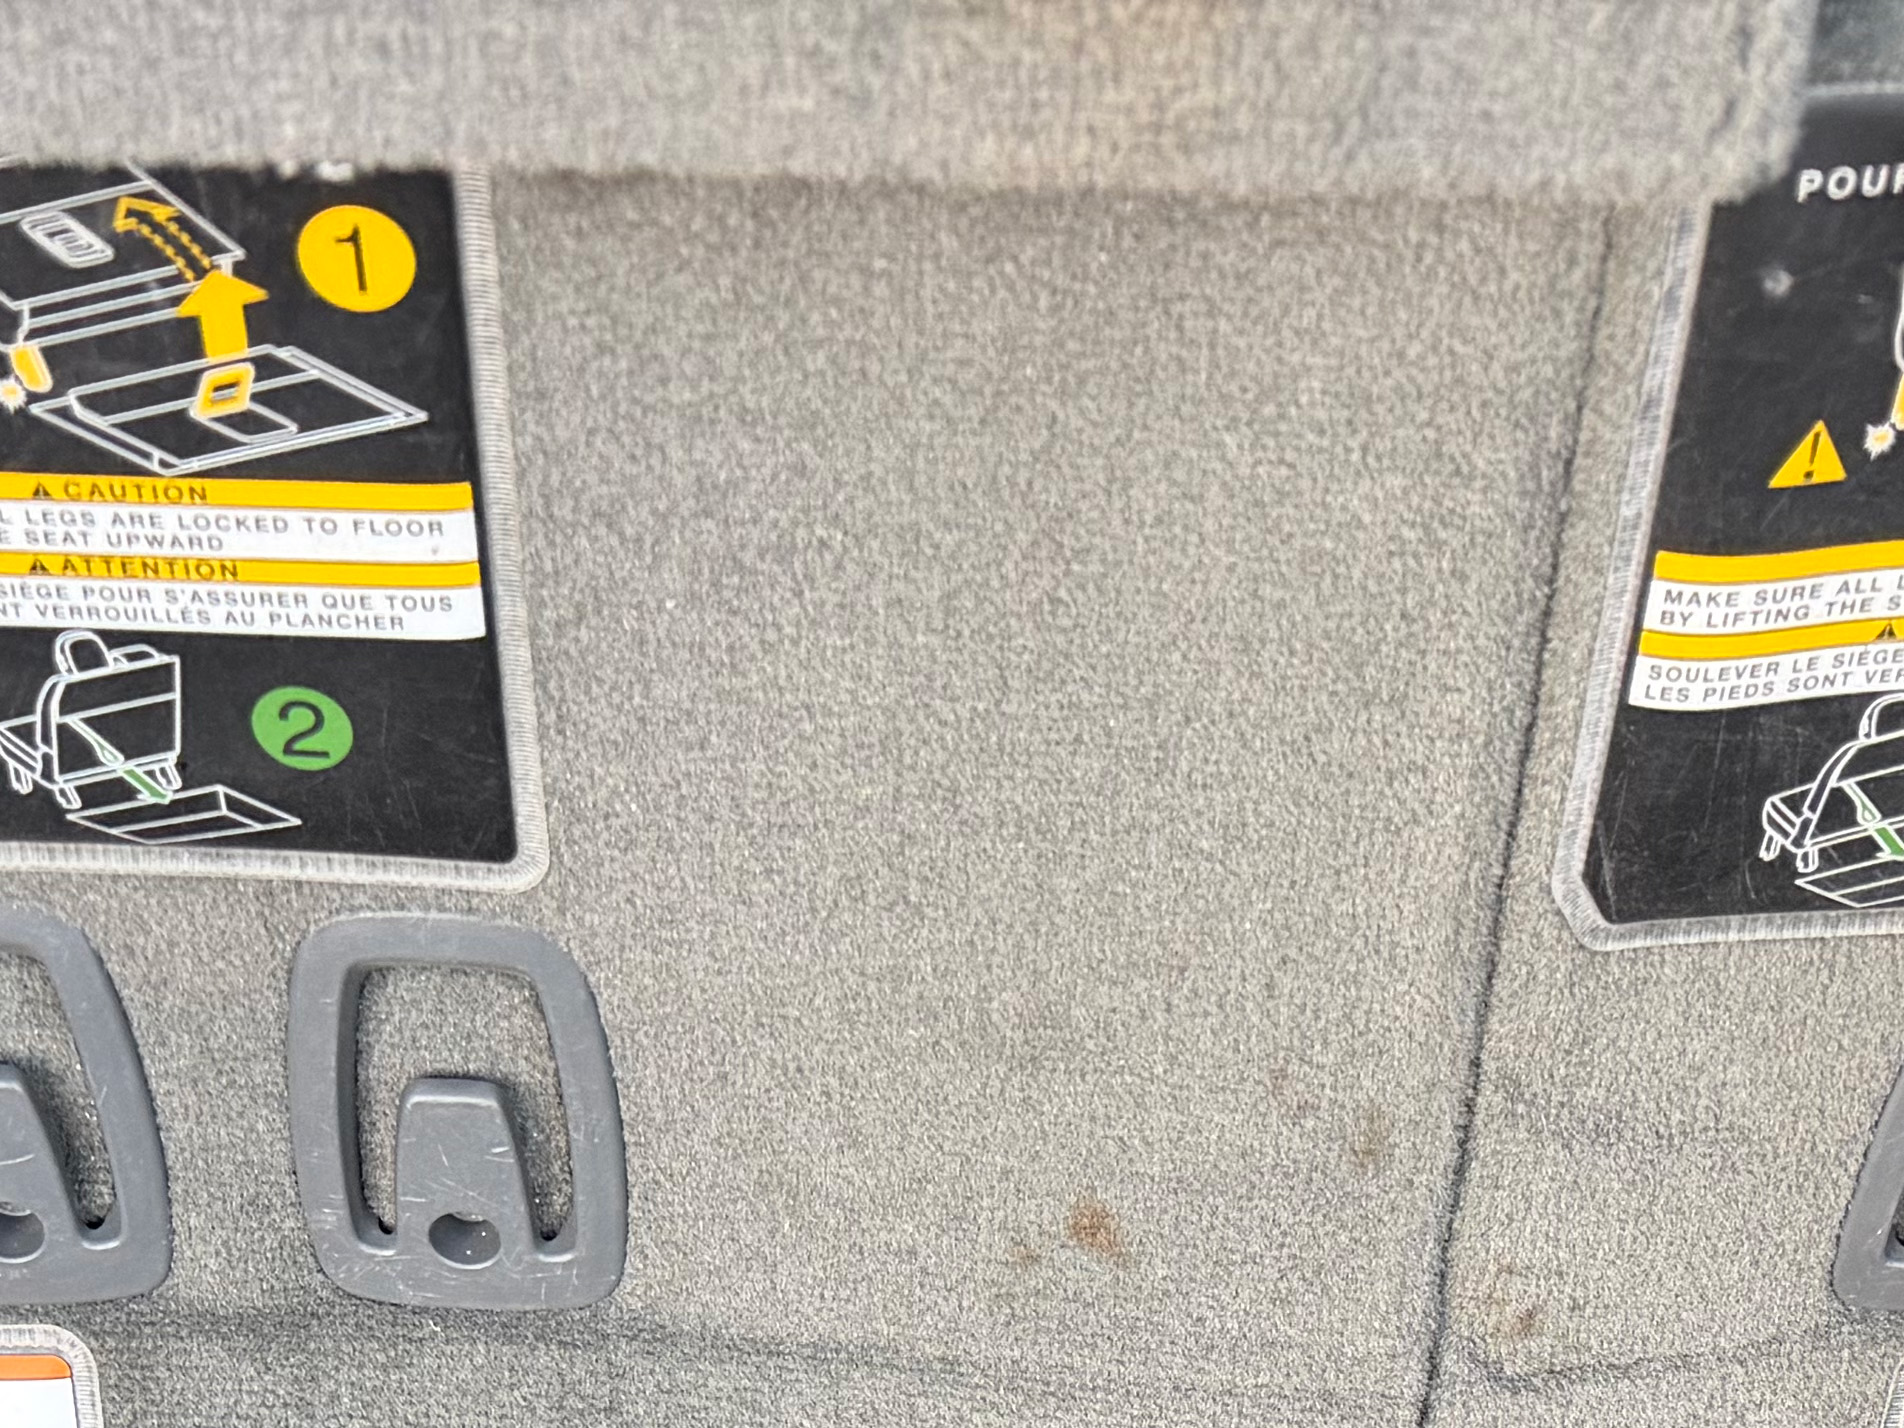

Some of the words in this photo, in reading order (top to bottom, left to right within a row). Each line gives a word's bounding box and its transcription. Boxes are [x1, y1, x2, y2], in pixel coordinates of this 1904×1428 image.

[334, 224, 367, 295] 1
[63, 482, 208, 502] CAUTION
[25, 507, 97, 528] LEGS
[110, 511, 165, 531] ARE
[177, 513, 289, 535] LOCKED
[304, 517, 338, 536] TO
[352, 518, 444, 538] FLOOR
[25, 529, 94, 548] SEAT
[106, 532, 223, 552] UPWARD
[60, 556, 239, 581] ATTENTION
[82, 583, 151, 602] POUR
[164, 587, 309, 609] S'ASSURER
[321, 592, 374, 611] QUE
[386, 593, 453, 613] TOUS
[1663, 588, 1740, 608] MAKE
[1754, 582, 1824, 603] SURE
[1835, 576, 1884, 596] ALL
[35, 602, 212, 626] VERROUILLÉS
[224, 608, 257, 627] AU
[269, 609, 405, 631] PLANCHER
[1660, 609, 1694, 628] BY
[1705, 607, 1810, 629] LIFTING
[1825, 597, 1873, 617] THE
[1648, 661, 1780, 684] SOULEVER
[1791, 655, 1819, 674] LE
[1831, 646, 1904, 668] SIÈGE
[1643, 684, 1689, 702] LES
[1702, 680, 1774, 701] PIEDS
[1786, 672, 1850, 693] SONT
[279, 701, 329, 758] 2
